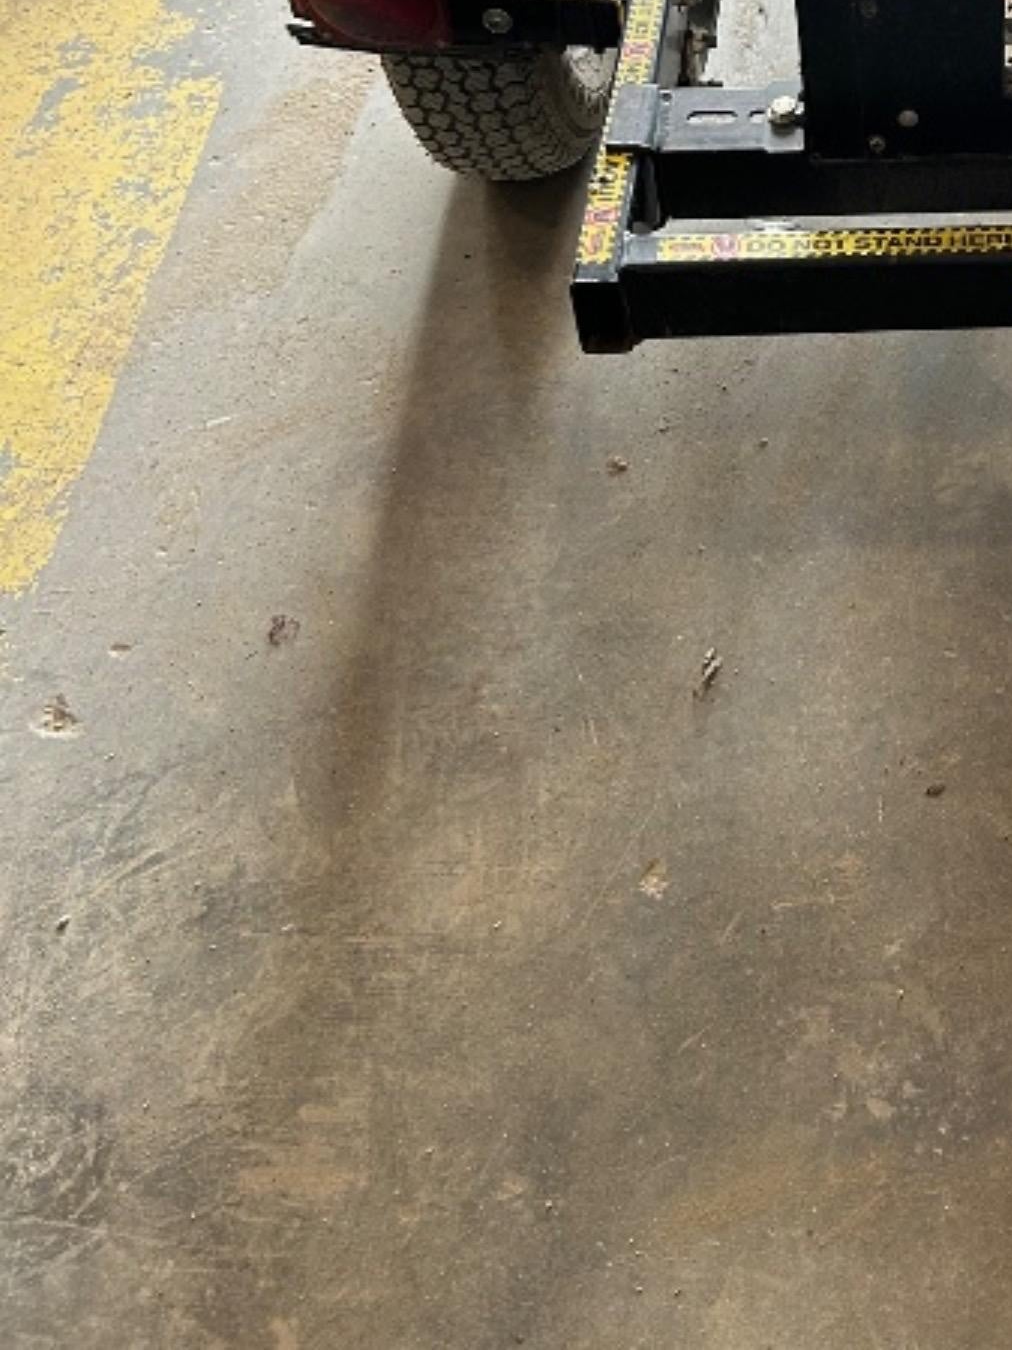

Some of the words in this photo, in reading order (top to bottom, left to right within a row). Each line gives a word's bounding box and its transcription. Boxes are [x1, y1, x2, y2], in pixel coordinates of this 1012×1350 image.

[746, 242, 786, 252] DO
[794, 240, 846, 252] NOT
[855, 235, 944, 250] STAND
